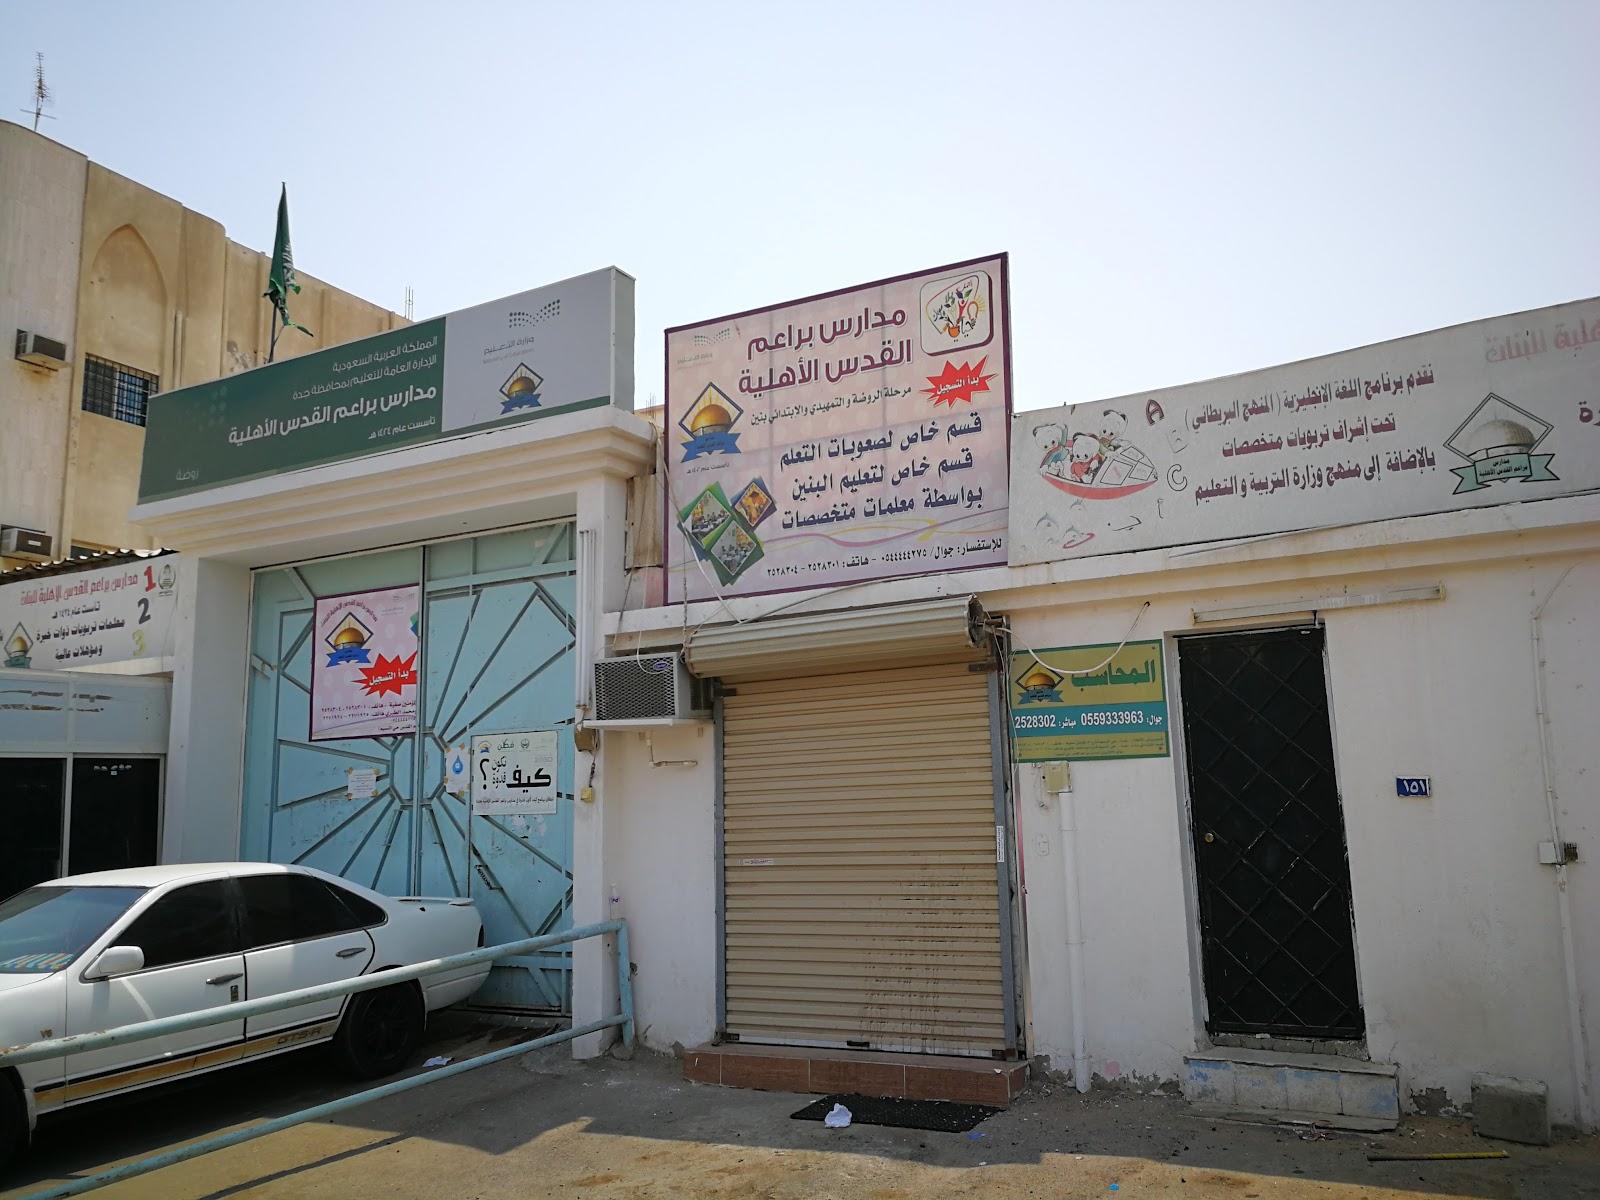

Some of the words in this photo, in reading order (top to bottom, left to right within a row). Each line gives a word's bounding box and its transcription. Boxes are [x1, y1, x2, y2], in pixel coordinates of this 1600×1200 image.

[819, 307, 906, 344] مدارس
[373, 345, 401, 362] العربية
[402, 336, 438, 353] المملكة
[747, 324, 813, 361] براعم
[332, 355, 374, 373] السعودية
[383, 362, 411, 378] العامة
[412, 355, 437, 371] الإدارة
[825, 339, 911, 383] القدس
[311, 380, 351, 397] بمحافظة
[351, 368, 384, 388] للتعليم
[738, 357, 818, 398] الأهلية
[1334, 377, 1361, 399] اللغة
[1364, 373, 1403, 401] برنامج
[1406, 363, 1434, 395] نقدم
[380, 384, 437, 412] مدارس
[852, 391, 883, 404] الروضة
[884, 385, 912, 398] مرحلة
[333, 398, 378, 424] براعم
[809, 396, 845, 416] التمهيدي
[1146, 400, 1165, 426] A
[228, 418, 277, 447] الأهلية
[279, 405, 331, 436] القدس
[750, 413, 767, 426] بنين
[947, 411, 982, 444] قسم
[1333, 416, 1368, 442] إشراف
[1371, 412, 1396, 433] تحت
[828, 430, 894, 462] لصعوبات
[899, 420, 940, 451] خاص
[1222, 433, 1283, 457] متخصصات
[1286, 424, 1330, 450] تربويات
[780, 443, 821, 472] التعلم
[892, 455, 930, 486] خاص
[938, 446, 973, 478] قسم
[1363, 454, 1380, 483] إلى
[1386, 446, 1436, 474] بالإضافة
[840, 464, 885, 495] لتعليم
[1166, 464, 1188, 492] C
[1249, 468, 1290, 496] التربية
[1293, 464, 1323, 490] وزارة
[1326, 458, 1362, 486] منهج
[792, 472, 833, 501] البنين
[923, 486, 983, 510] بواسطة
[1195, 475, 1238, 506] التعليم
[781, 501, 856, 529] متخصصات
[863, 496, 915, 518] معلمات
[64, 580, 88, 600] القدس
[91, 577, 110, 594] براعم
[110, 573, 138, 591] مدارس
[144, 565, 156, 592] 1
[99, 617, 125, 631] معلمات
[137, 598, 151, 624] 2
[71, 622, 97, 637] تربويات
[132, 629, 145, 656] 3
[369, 670, 396, 686] التسجيل
[398, 667, 410, 679] بدأ
[1015, 715, 1056, 729] 2528302
[1081, 711, 1144, 726] 0559333963
[506, 764, 552, 793] كيف
[1402, 780, 1425, 793] ١٥١
